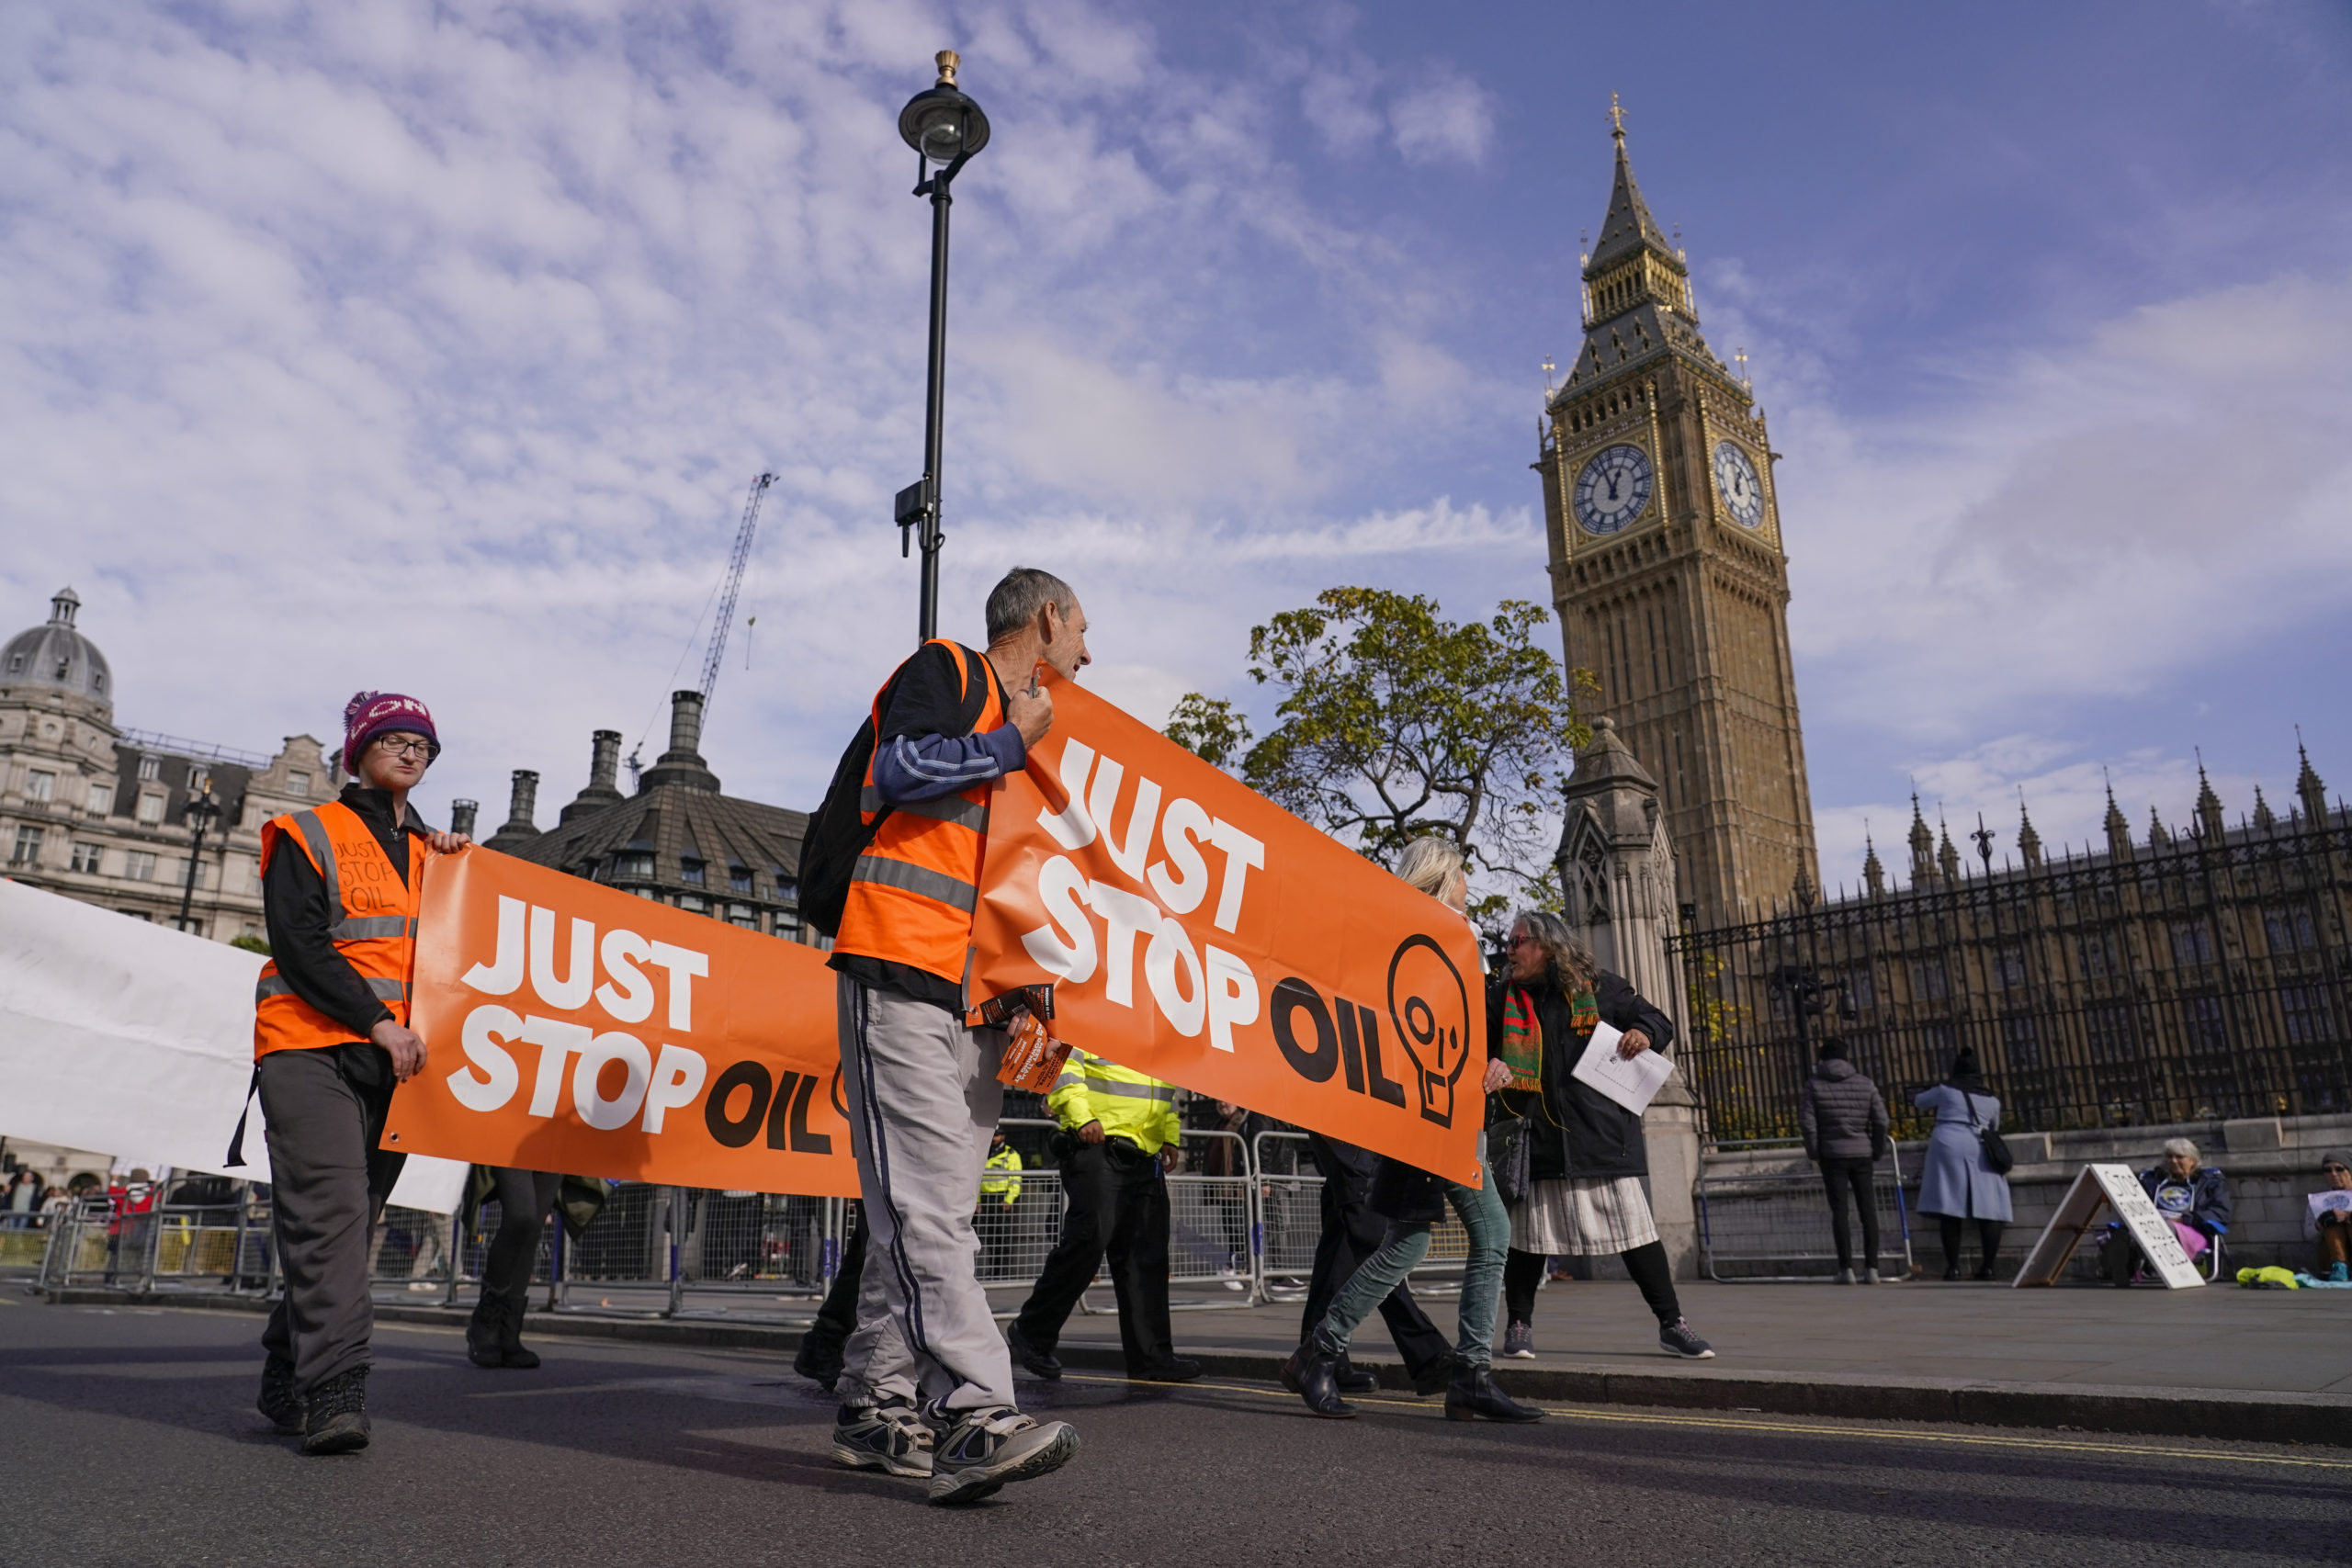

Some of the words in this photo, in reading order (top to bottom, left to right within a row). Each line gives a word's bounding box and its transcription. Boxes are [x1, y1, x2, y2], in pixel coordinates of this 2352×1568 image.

[335, 841, 378, 858] JUST
[339, 862, 393, 887] STOP
[350, 886, 396, 912] OIL
[1036, 737, 1264, 934] JUST
[460, 894, 709, 1032] JUST
[1021, 854, 1260, 1053] STOP
[1271, 976, 1406, 1109] OIL
[447, 1004, 707, 1134] STOP
[704, 1060, 832, 1155] OIL
